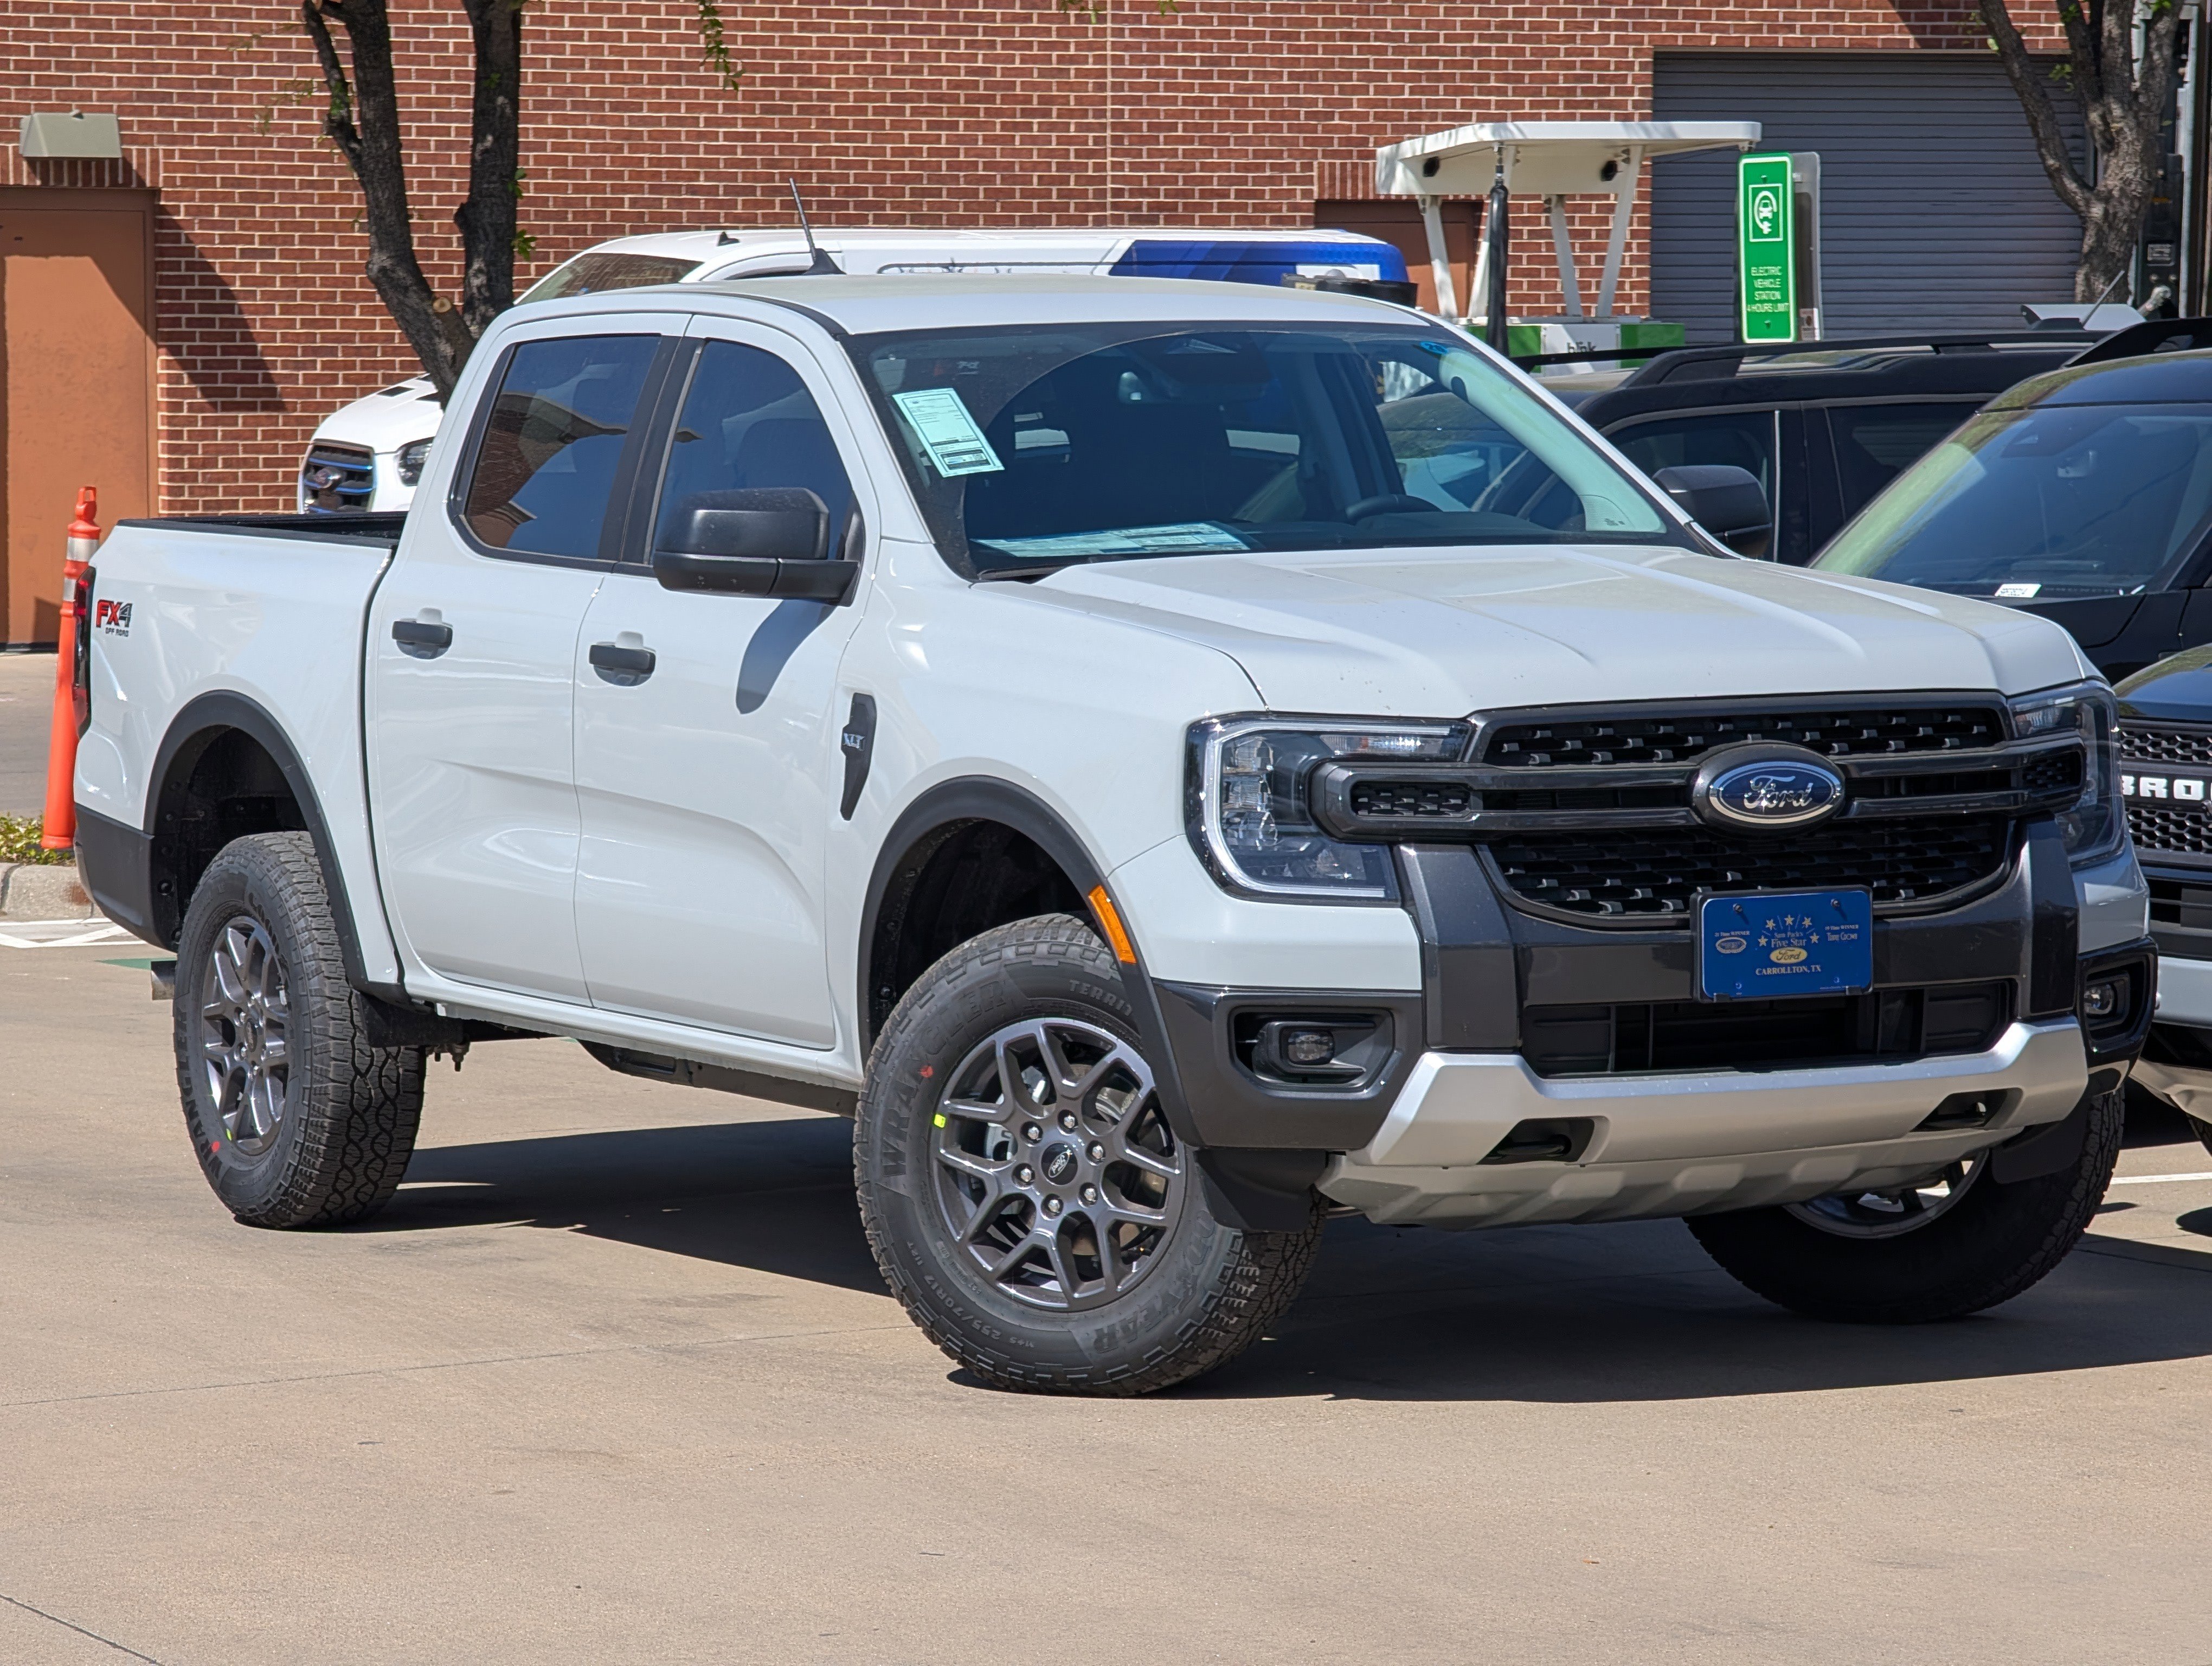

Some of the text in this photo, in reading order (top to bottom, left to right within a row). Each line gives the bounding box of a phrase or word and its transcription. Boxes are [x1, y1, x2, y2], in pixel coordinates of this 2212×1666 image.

[1753, 279, 1781, 288] VEHICLE
[1754, 291, 1781, 300] STATION
[96, 599, 133, 628] FX4
[1744, 775, 1814, 809] Ford
[1771, 937, 1807, 948] Five Star
[1776, 949, 1801, 961] Ford
[1756, 966, 1810, 976] CARROLLTON,
[1051, 1155, 1066, 1174] Ford
[924, 1275, 1002, 1340] 255/70R17
